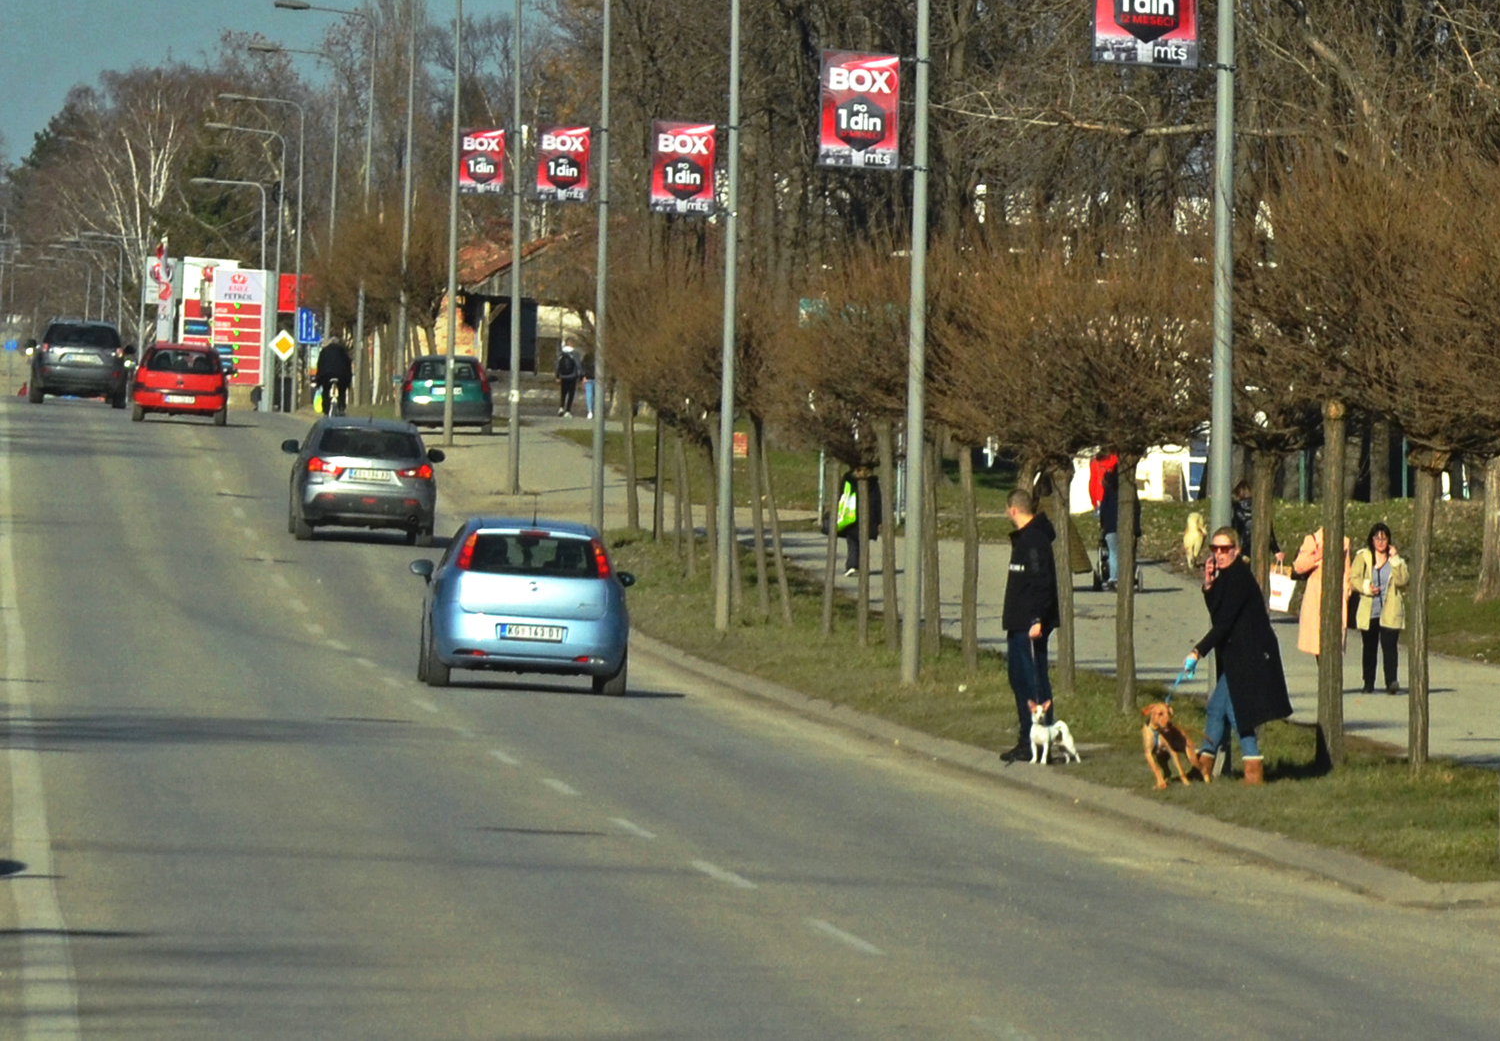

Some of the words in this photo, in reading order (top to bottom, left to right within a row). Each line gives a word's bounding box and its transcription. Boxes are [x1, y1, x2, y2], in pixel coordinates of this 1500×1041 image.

[1132, 15, 1174, 27] MESECI
[1154, 45, 1188, 60] mts
[829, 67, 891, 93] BOX
[853, 103, 867, 112] PO
[838, 108, 848, 129] 1
[850, 113, 881, 131] din
[463, 136, 500, 151] BOX
[542, 134, 585, 152] BOX
[658, 133, 709, 155] BOX
[468, 160, 475, 172] 1
[475, 162, 495, 173] din
[865, 153, 891, 165] mts
[548, 161, 555, 175] 1
[556, 164, 578, 177] din
[665, 166, 673, 183] 1
[675, 169, 701, 184] din
[687, 201, 708, 211] mts
